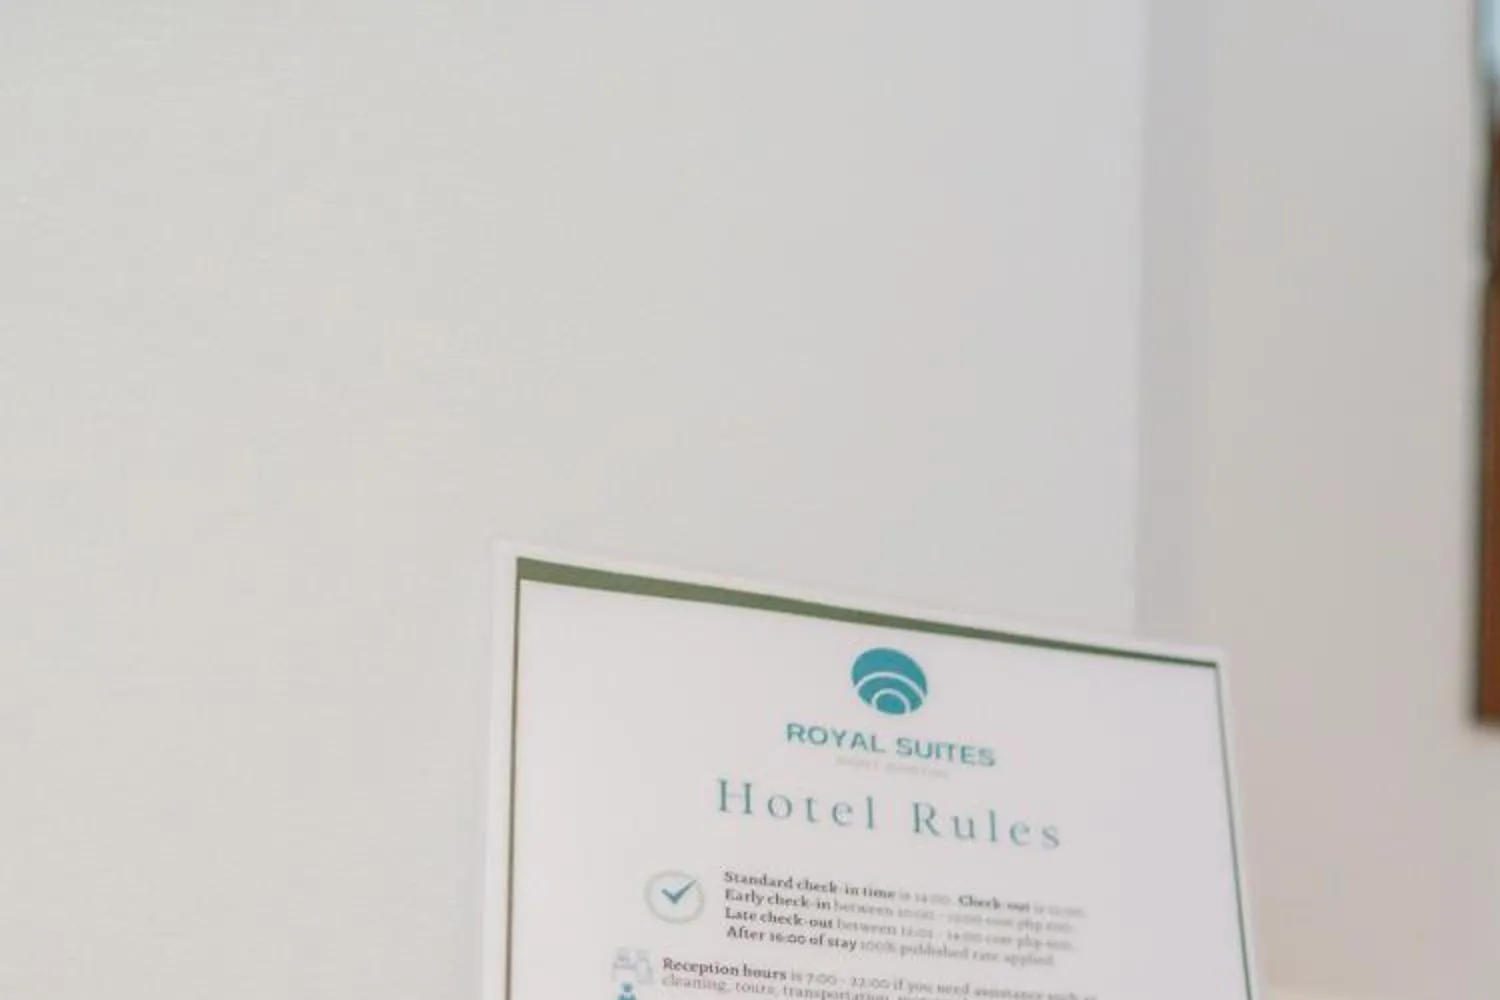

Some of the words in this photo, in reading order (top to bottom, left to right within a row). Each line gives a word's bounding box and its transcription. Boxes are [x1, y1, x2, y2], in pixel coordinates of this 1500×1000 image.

[785, 721, 886, 753] ROYAL
[895, 736, 997, 767] SUITES
[717, 777, 876, 831] Hotel
[912, 800, 1061, 850] Rules
[723, 870, 793, 889] Standard
[796, 878, 859, 896] check-in
[863, 885, 896, 900] time
[725, 887, 764, 907] Early
[768, 892, 831, 910] check-in
[725, 905, 757, 921] Late
[759, 910, 833, 929] check-out
[727, 925, 764, 941] After
[810, 933, 826, 946] of
[828, 936, 856, 952] stay
[663, 957, 739, 977] Reception
[743, 964, 786, 981] hours
[908, 982, 933, 994] you
[937, 982, 970, 995] need
